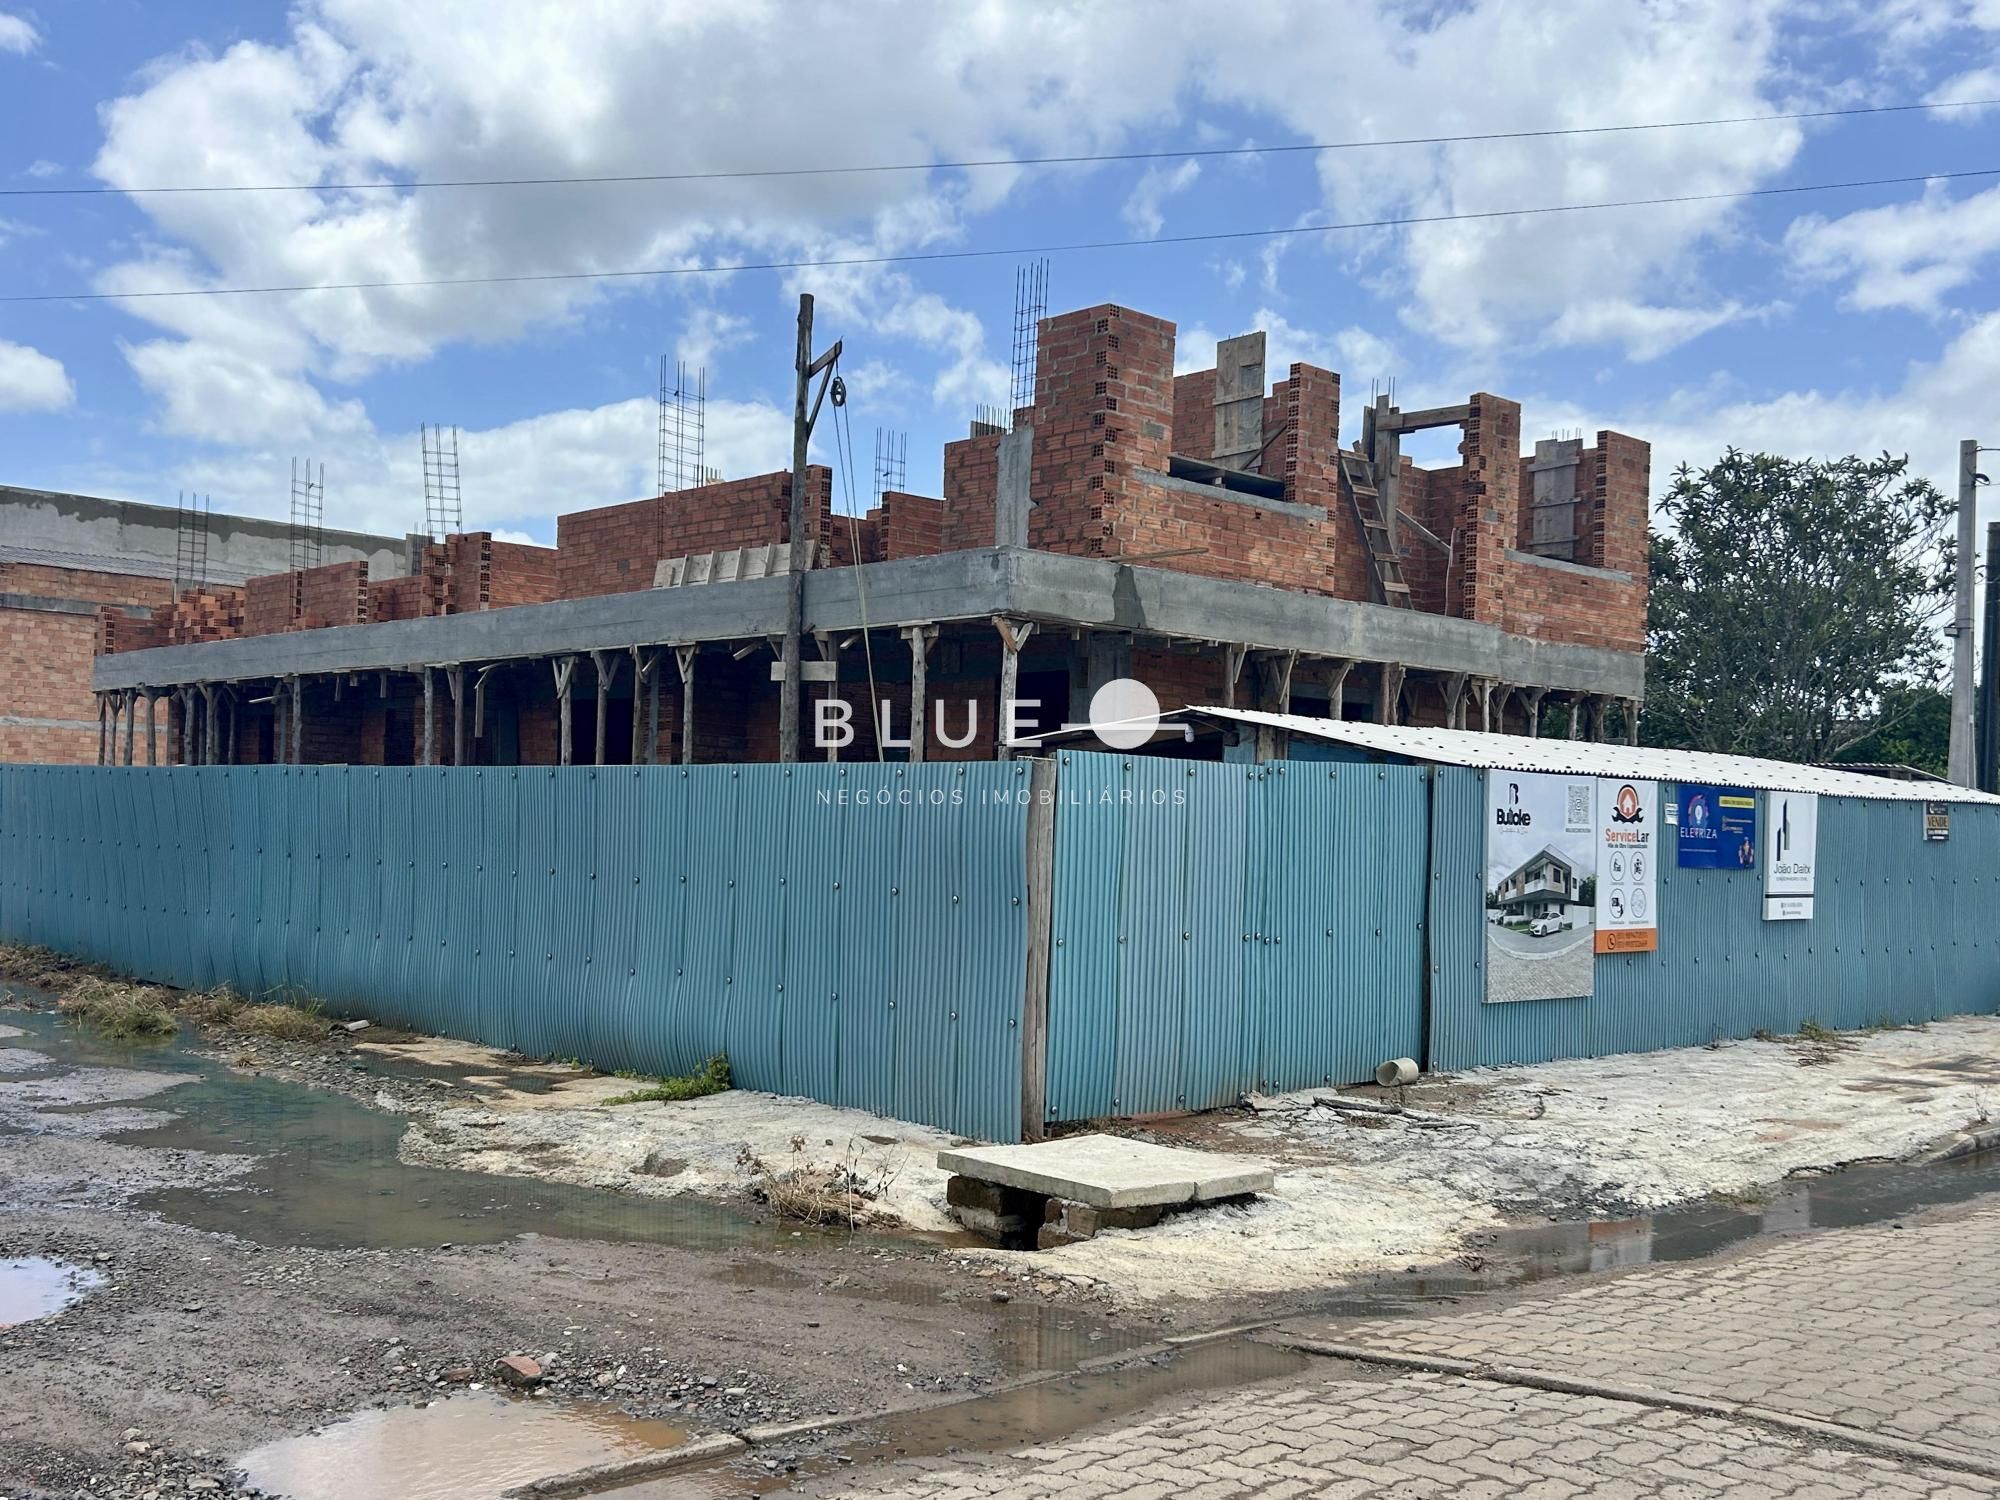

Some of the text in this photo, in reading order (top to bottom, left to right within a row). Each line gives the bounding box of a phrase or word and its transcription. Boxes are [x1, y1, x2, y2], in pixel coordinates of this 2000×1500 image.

[1928, 816, 1948, 827] VENDE
[1605, 828, 1650, 842] ServiceLar
[1680, 827, 1718, 839] ELETRIZA
[1774, 863, 1791, 874] João
